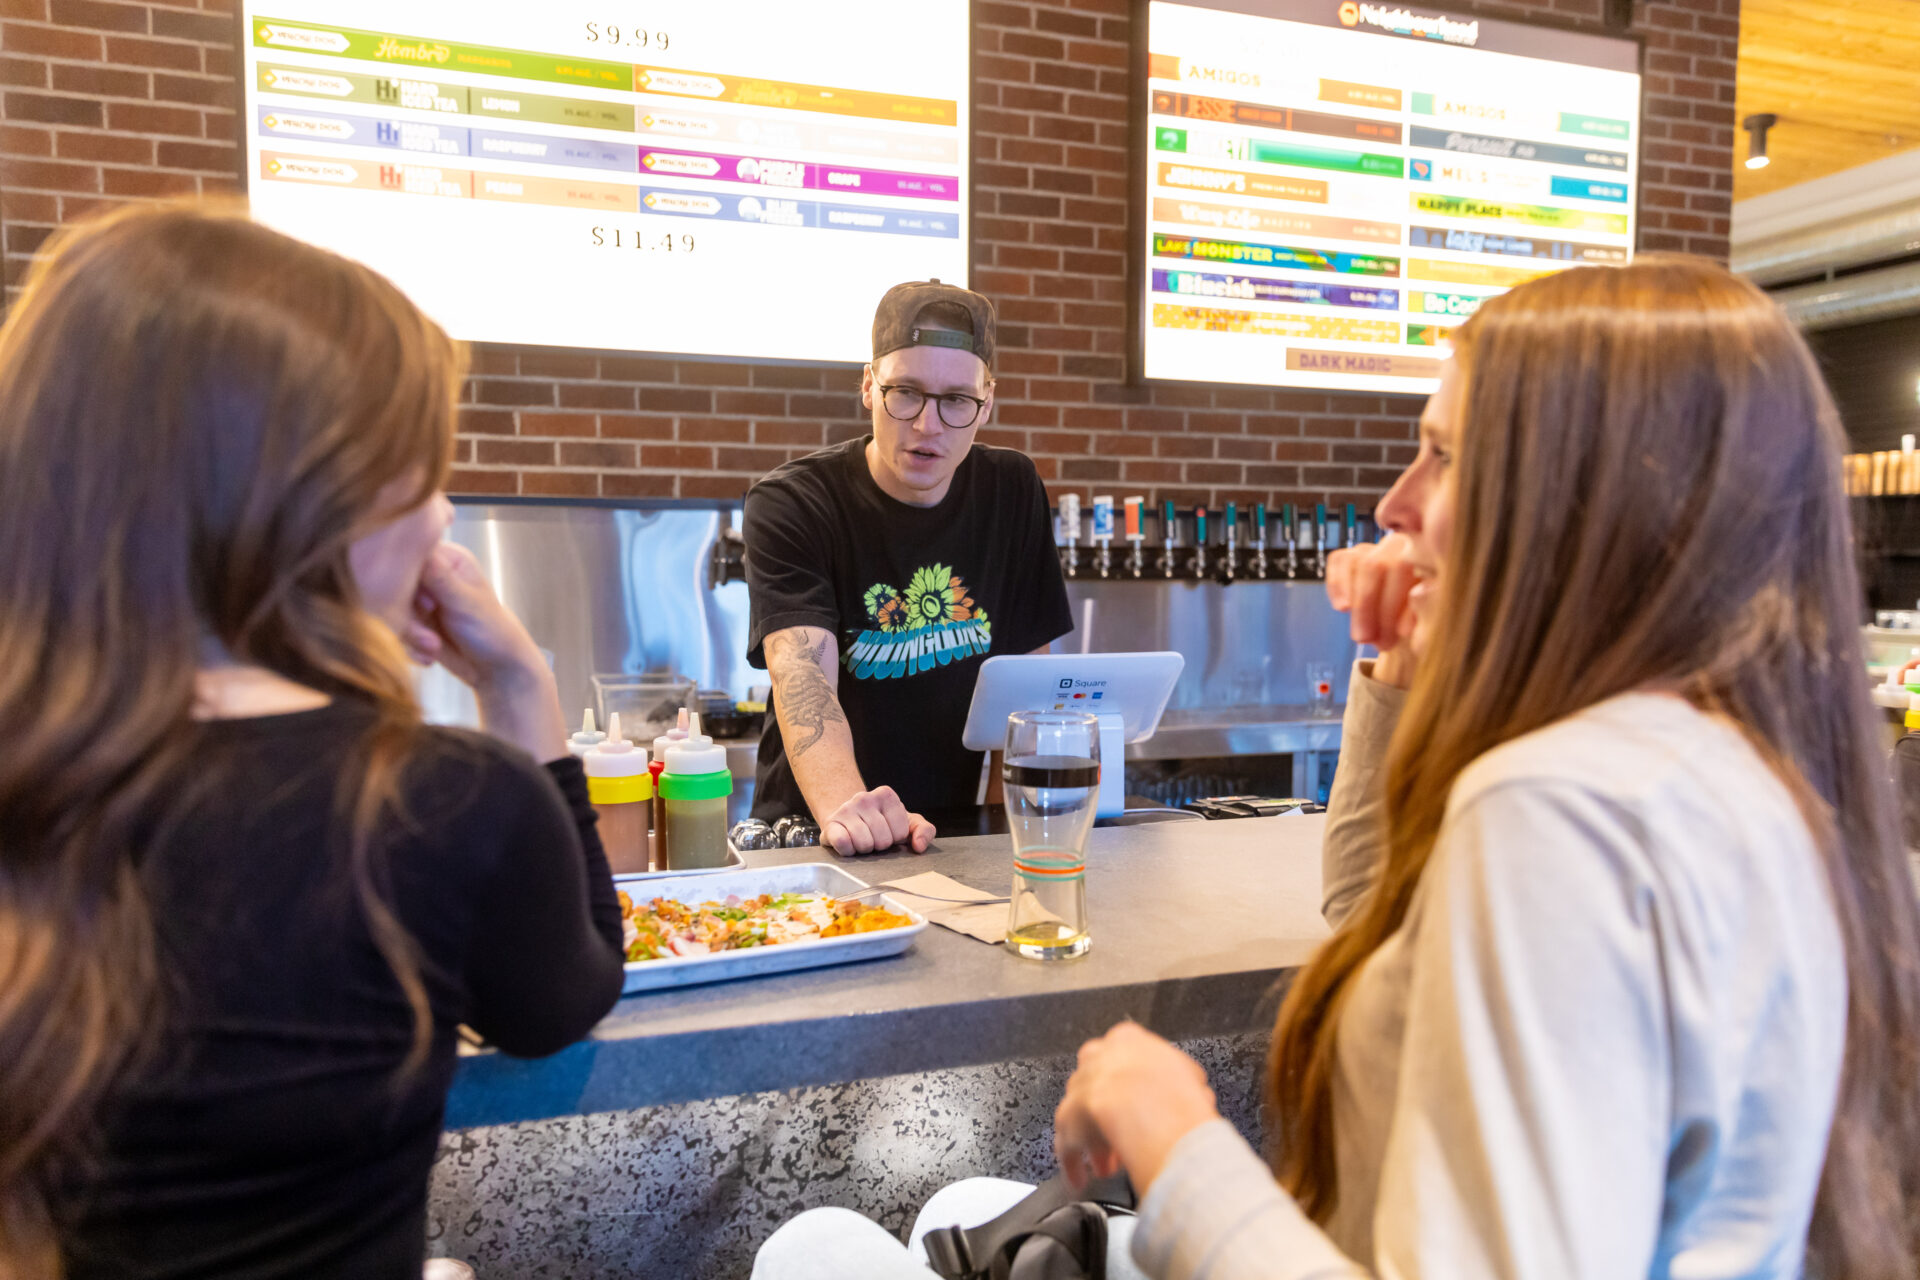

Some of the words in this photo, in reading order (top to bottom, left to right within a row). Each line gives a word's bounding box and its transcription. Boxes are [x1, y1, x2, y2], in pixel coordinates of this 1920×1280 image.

[586, 21, 671, 52] $9.99
[1187, 64, 1262, 88] AMIGOS
[1417, 198, 1461, 213] HAPPY
[1464, 203, 1503, 216] PLACE
[591, 226, 696, 254] $11.49
[1192, 241, 1273, 262] MONSTER
[1299, 353, 1343, 370] DARK
[1345, 355, 1393, 373] MAGIC
[1074, 680, 1107, 688] Square
